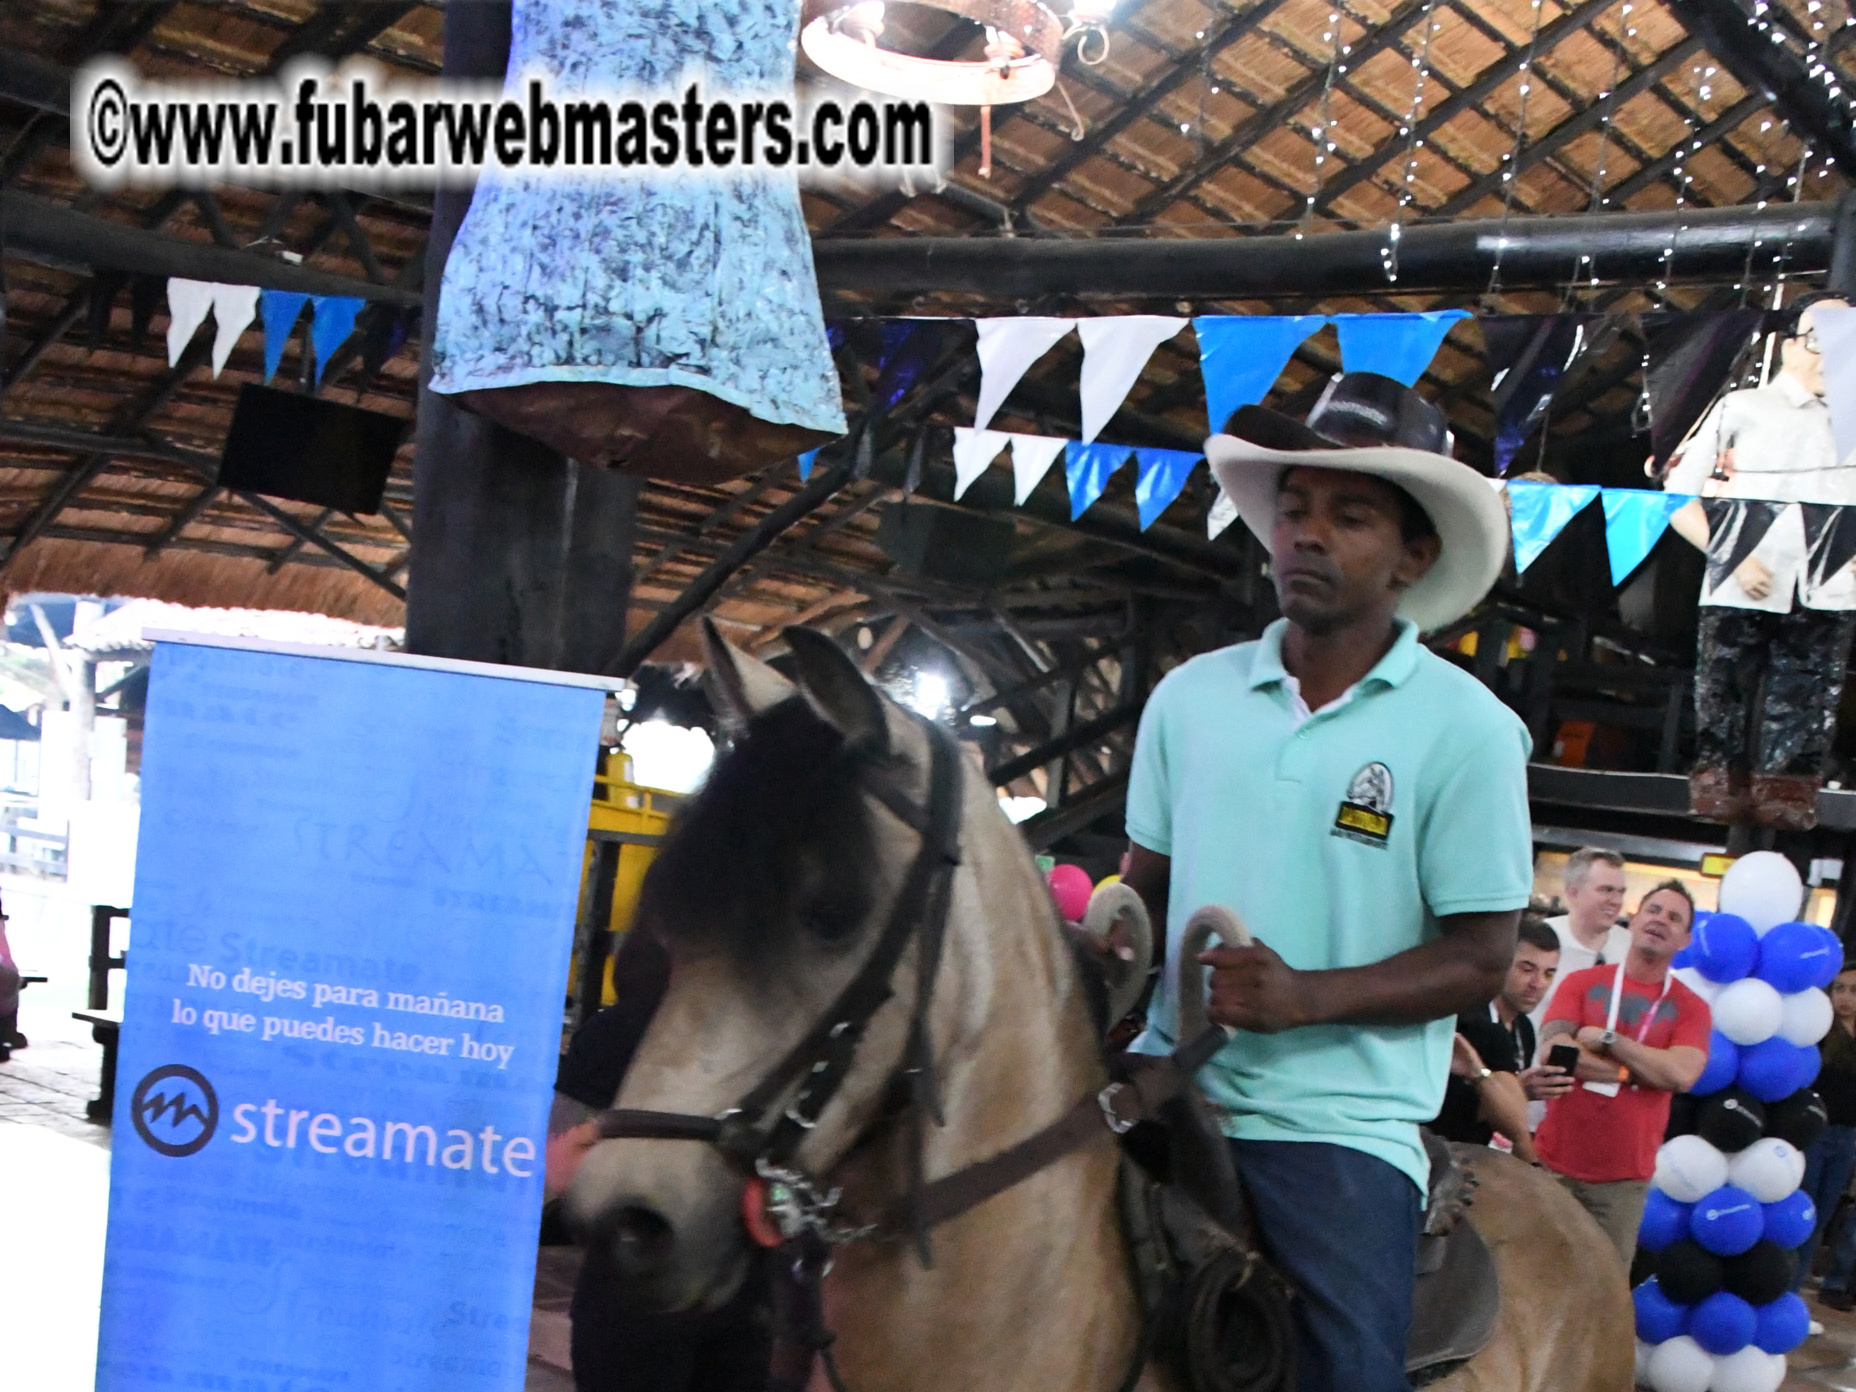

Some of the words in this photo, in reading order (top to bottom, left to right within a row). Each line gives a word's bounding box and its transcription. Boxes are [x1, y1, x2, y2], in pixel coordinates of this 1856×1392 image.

[186, 963, 226, 990] No
[232, 967, 307, 1002] dejes
[312, 983, 379, 1008] para
[387, 991, 505, 1023] mañana
[171, 998, 197, 1025] lo
[203, 1009, 256, 1035] que
[260, 1016, 365, 1045] puedes
[371, 1021, 455, 1055] hacer
[459, 1033, 515, 1069] hoy
[230, 1099, 537, 1178] streamate
